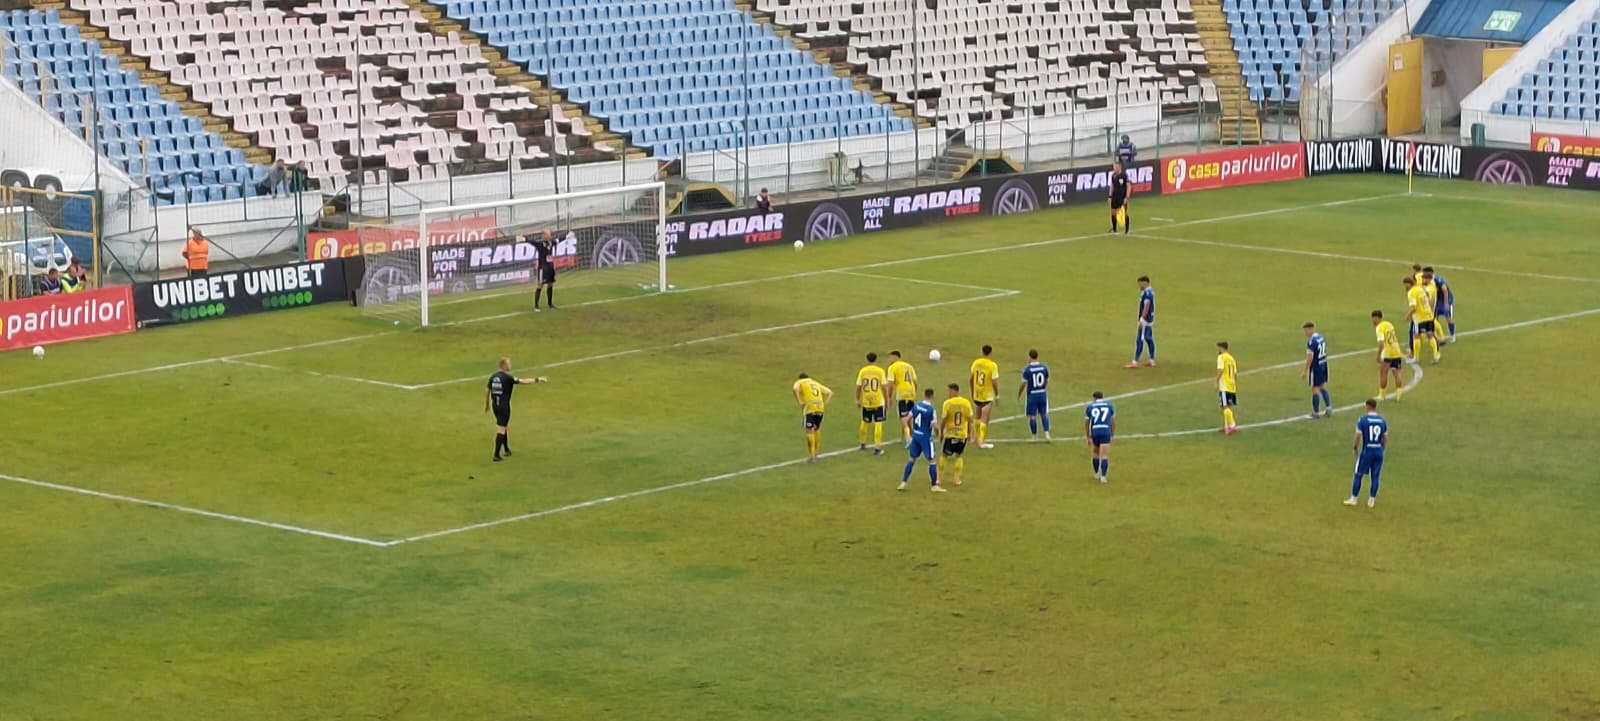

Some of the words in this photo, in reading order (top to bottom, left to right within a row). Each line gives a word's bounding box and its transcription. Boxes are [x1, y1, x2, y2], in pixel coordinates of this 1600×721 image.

[1188, 162, 1220, 181] casa
[1221, 151, 1299, 181] pariurilor
[1548, 155, 1585, 169] MADE
[1047, 173, 1074, 186] MADE
[1075, 166, 1154, 191] RAAR
[1547, 166, 1573, 177] FOR
[1546, 174, 1569, 186] ALL
[1048, 184, 1067, 196] FOR
[862, 196, 891, 210] MADE
[893, 186, 983, 215] RADAR
[1049, 194, 1065, 205] ALL
[863, 207, 883, 221] FOR
[688, 212, 784, 240] RADAR
[863, 218, 882, 231] ALL
[431, 247, 466, 262] MADE
[470, 237, 577, 268] RADR
[432, 260, 458, 273] FOR
[152, 273, 238, 308] UNIBET
[243, 262, 326, 295] UNIBET
[7, 298, 125, 340] pariurilor
[861, 377, 879, 393] 20
[1032, 372, 1045, 388] 10
[914, 411, 923, 429] 4
[1091, 407, 1110, 423] 97
[1369, 424, 1382, 442] 19
